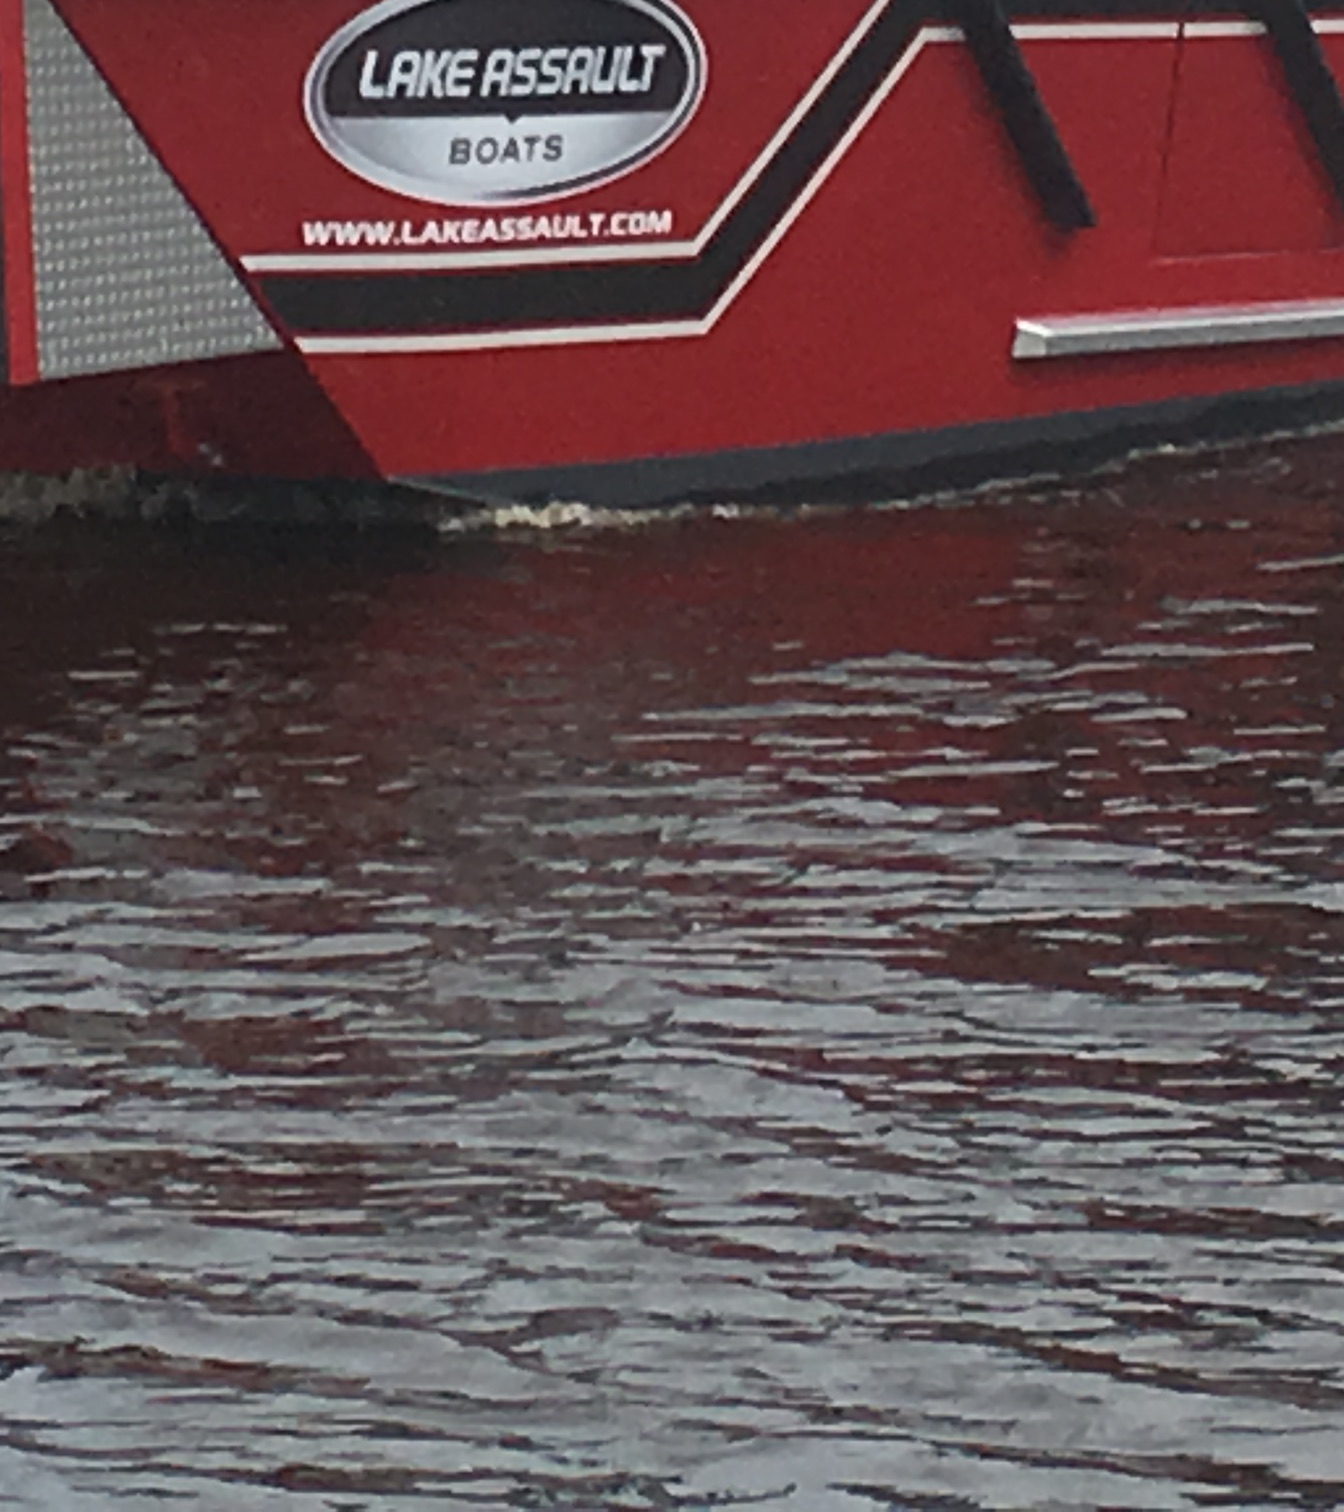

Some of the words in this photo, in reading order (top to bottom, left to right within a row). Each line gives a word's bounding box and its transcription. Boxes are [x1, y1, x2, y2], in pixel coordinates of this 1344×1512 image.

[359, 49, 479, 99] LAKE
[479, 44, 666, 97] ASSAULT
[448, 135, 563, 165] BOATS
[301, 210, 673, 246] WWW.LAKEASSAULT.COM
